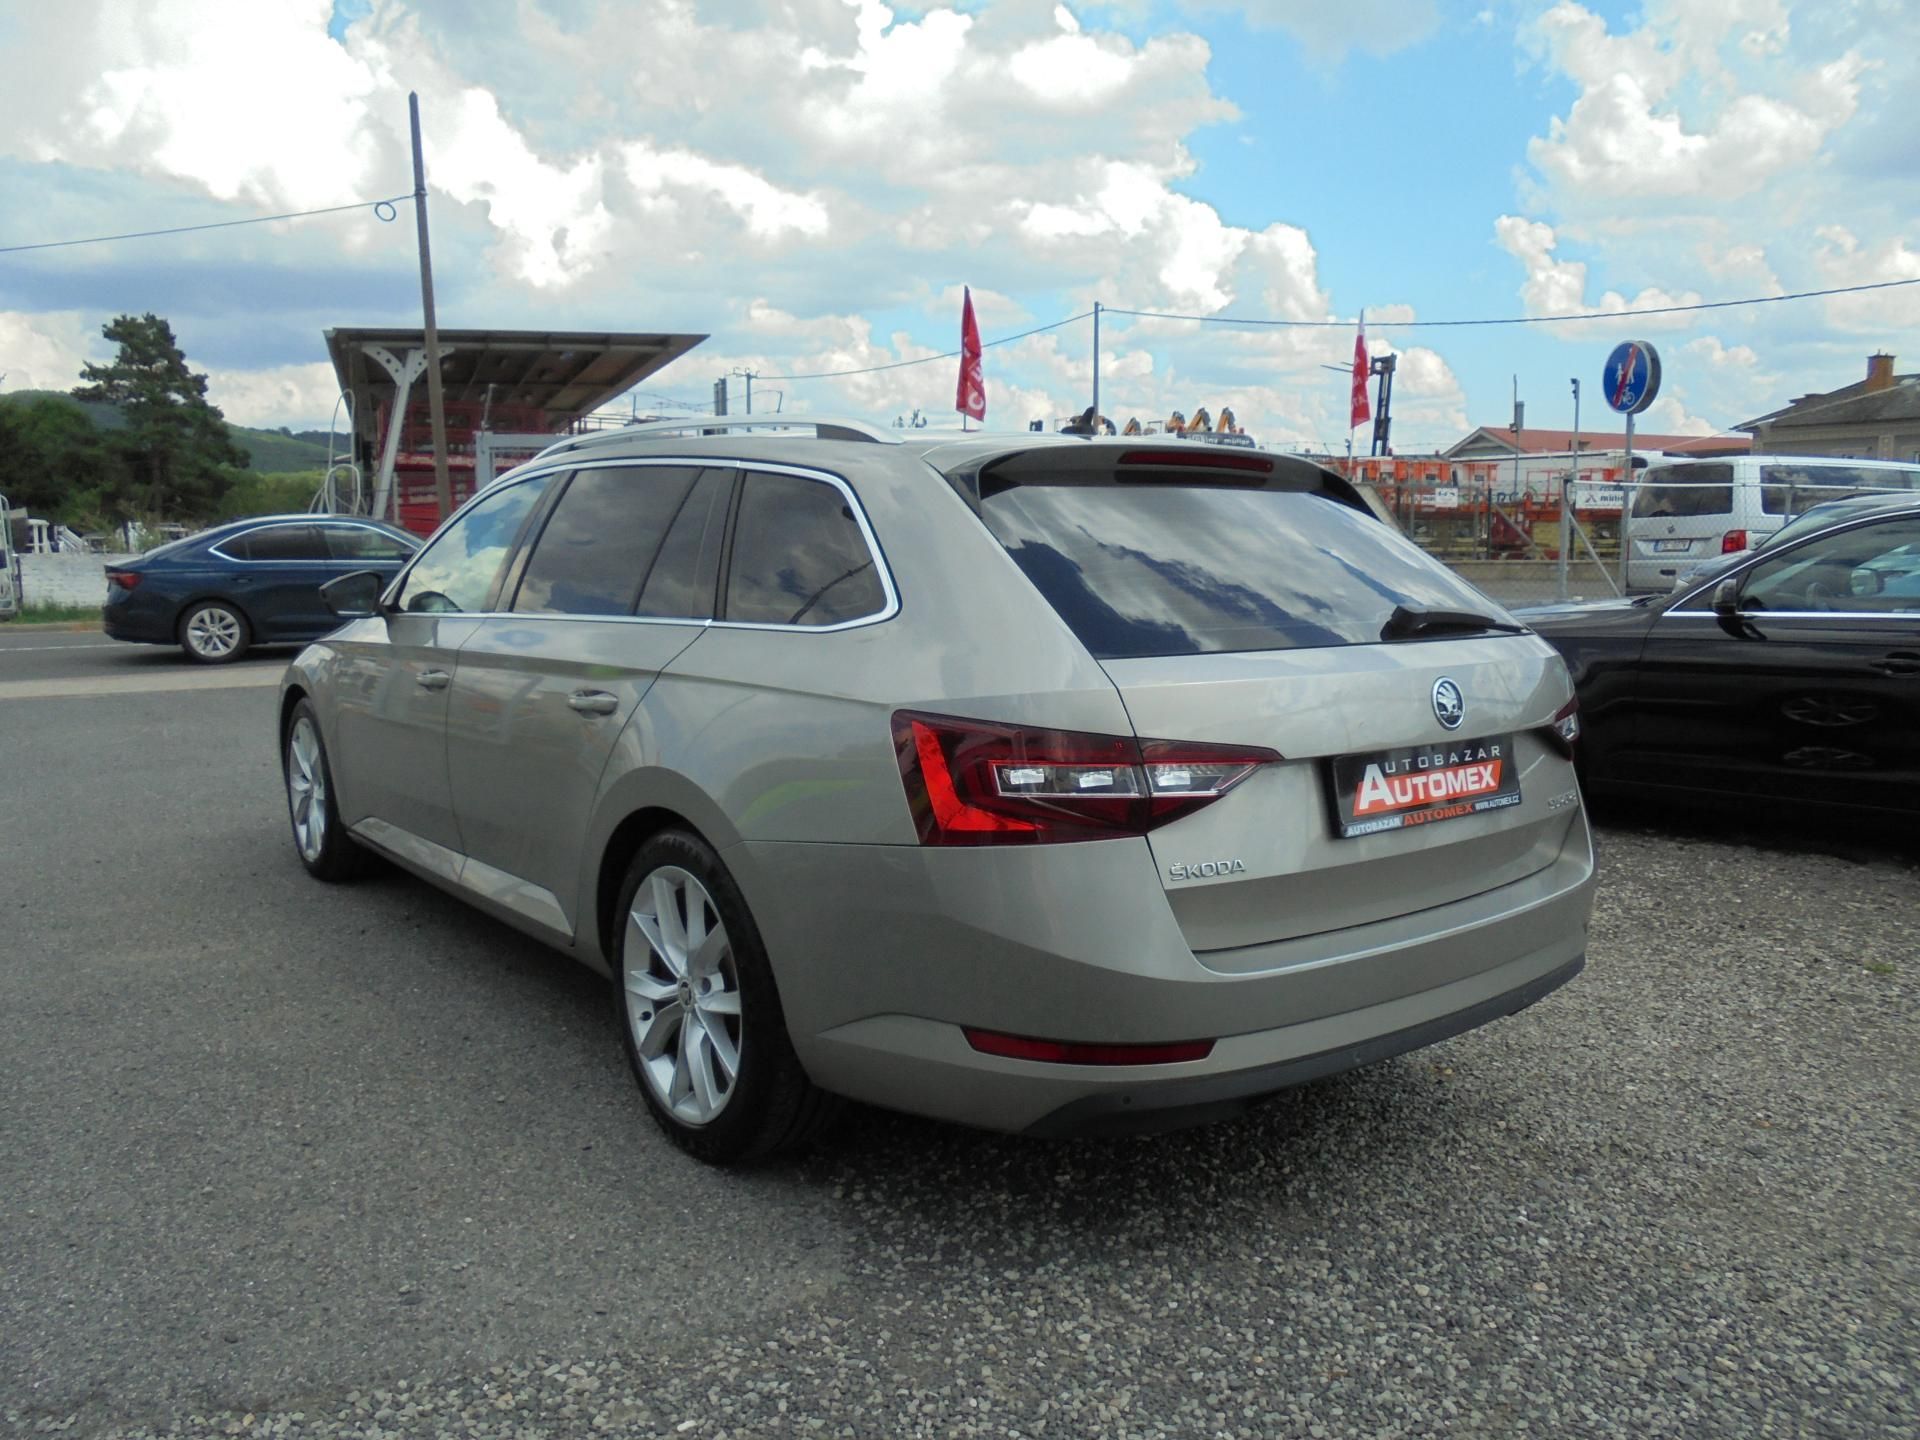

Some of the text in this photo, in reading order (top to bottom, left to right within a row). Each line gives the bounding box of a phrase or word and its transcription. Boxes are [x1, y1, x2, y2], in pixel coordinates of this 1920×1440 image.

[1359, 763, 1497, 810] AUTOMEX
[1345, 816, 1401, 838] AUTOBAZAR
[1404, 803, 1473, 826] AUTOMEX
[1169, 859, 1246, 881] ŠKODA
